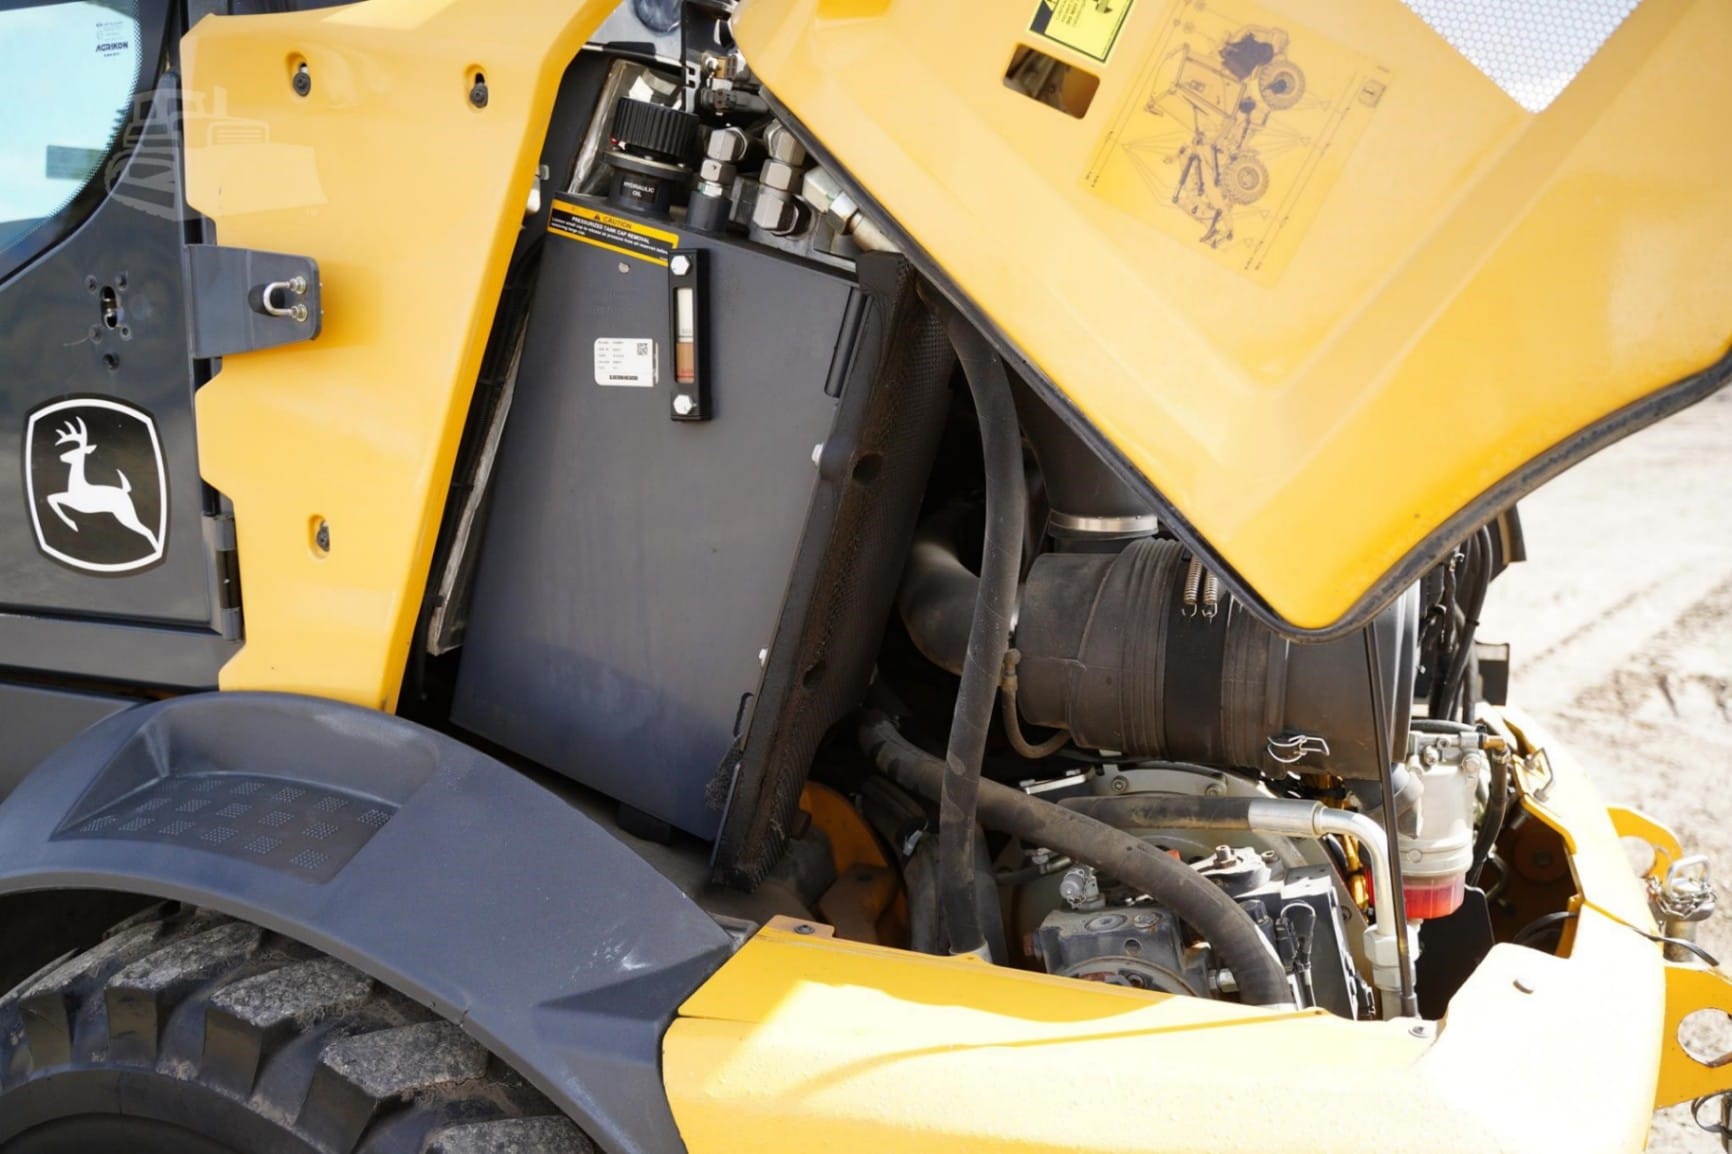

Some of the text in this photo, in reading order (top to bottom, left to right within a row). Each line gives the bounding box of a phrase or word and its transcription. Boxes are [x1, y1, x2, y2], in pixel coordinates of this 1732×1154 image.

[623, 181, 655, 193] HYDRAULIC
[632, 190, 642, 198] OIL
[603, 215, 632, 229] CAUTION
[617, 229, 627, 237] CAP
[627, 232, 650, 244] REMOVAL
